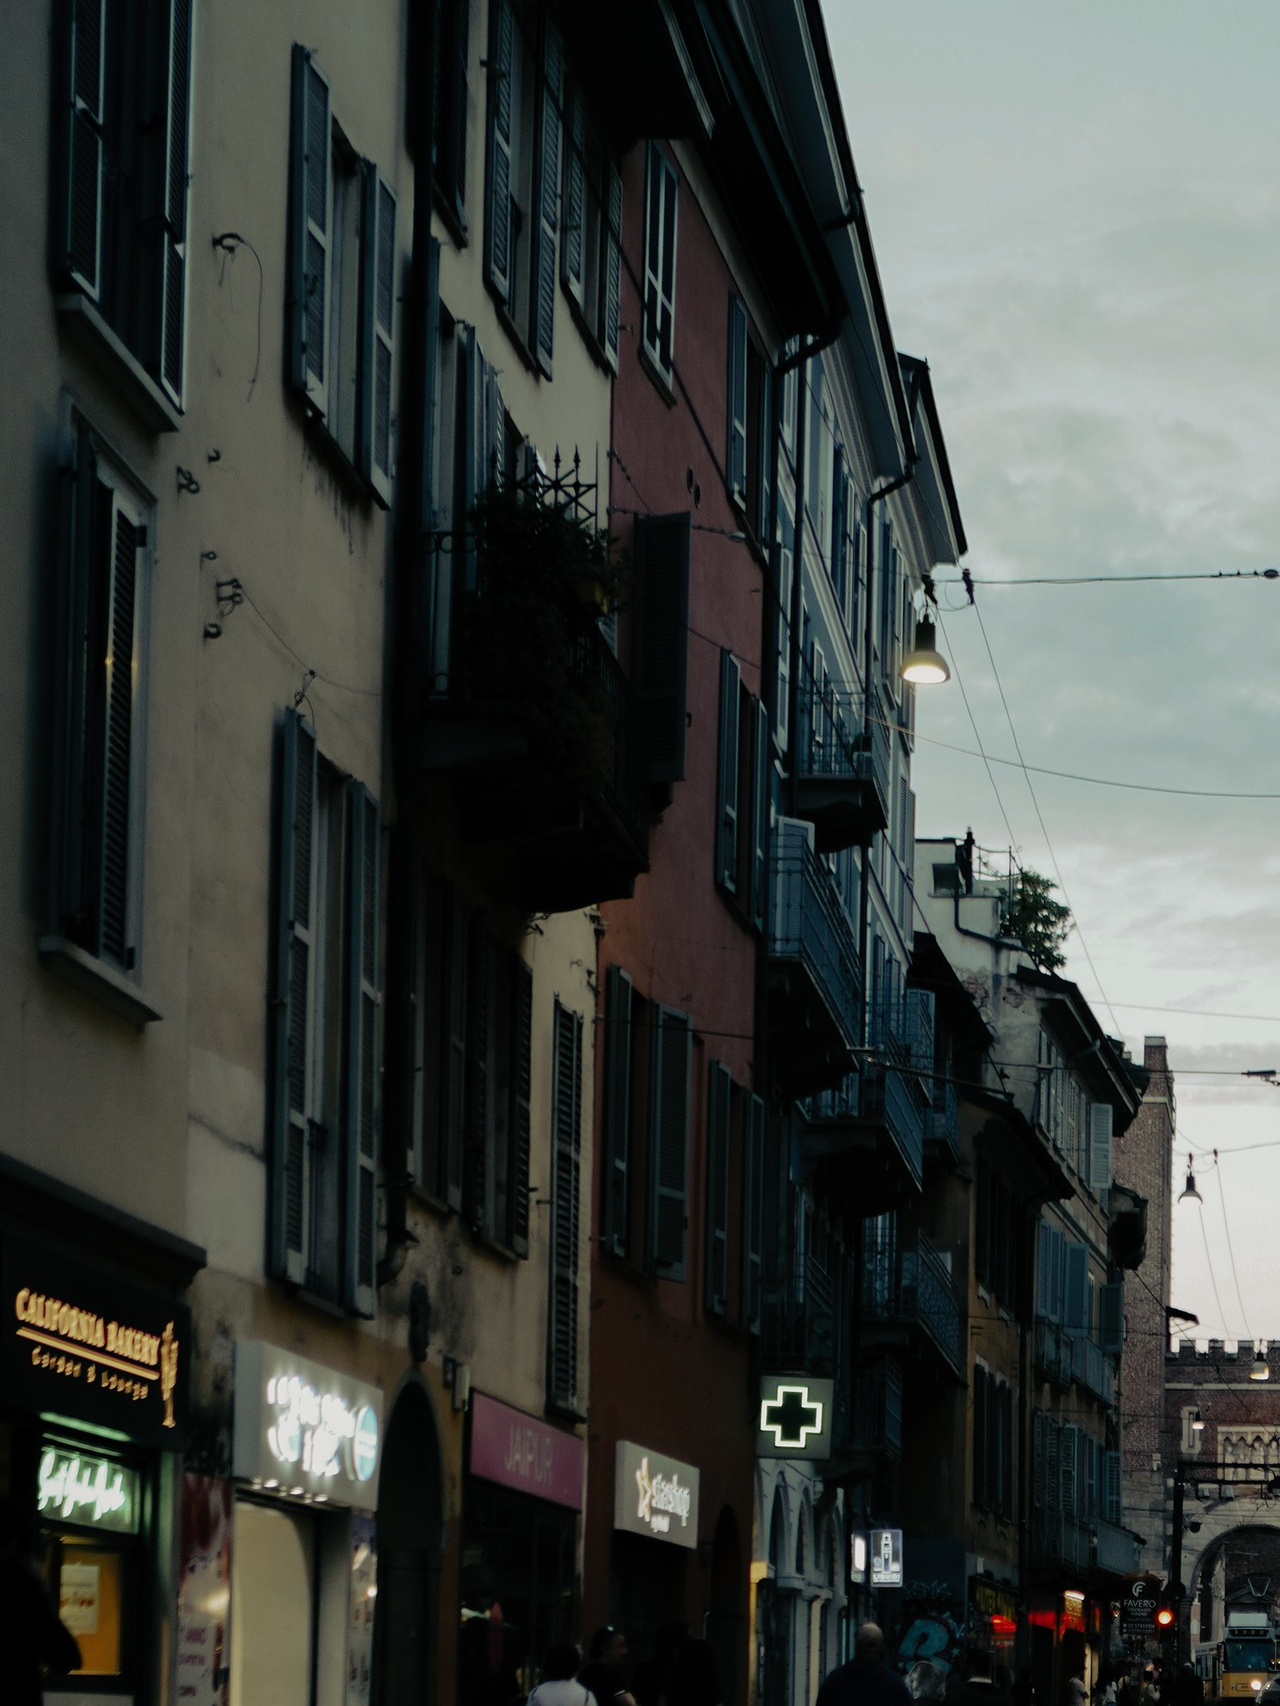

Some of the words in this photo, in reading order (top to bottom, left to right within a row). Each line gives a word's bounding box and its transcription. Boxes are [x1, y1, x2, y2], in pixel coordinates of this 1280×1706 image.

[16, 1287, 105, 1347] CALIFORNIA
[105, 1320, 161, 1366] BAKERY
[32, 1345, 82, 1378] Garden
[101, 1371, 149, 1400] Lounge
[504, 1421, 554, 1486] JAIPUR
[1123, 1599, 1157, 1608] FAVERO
